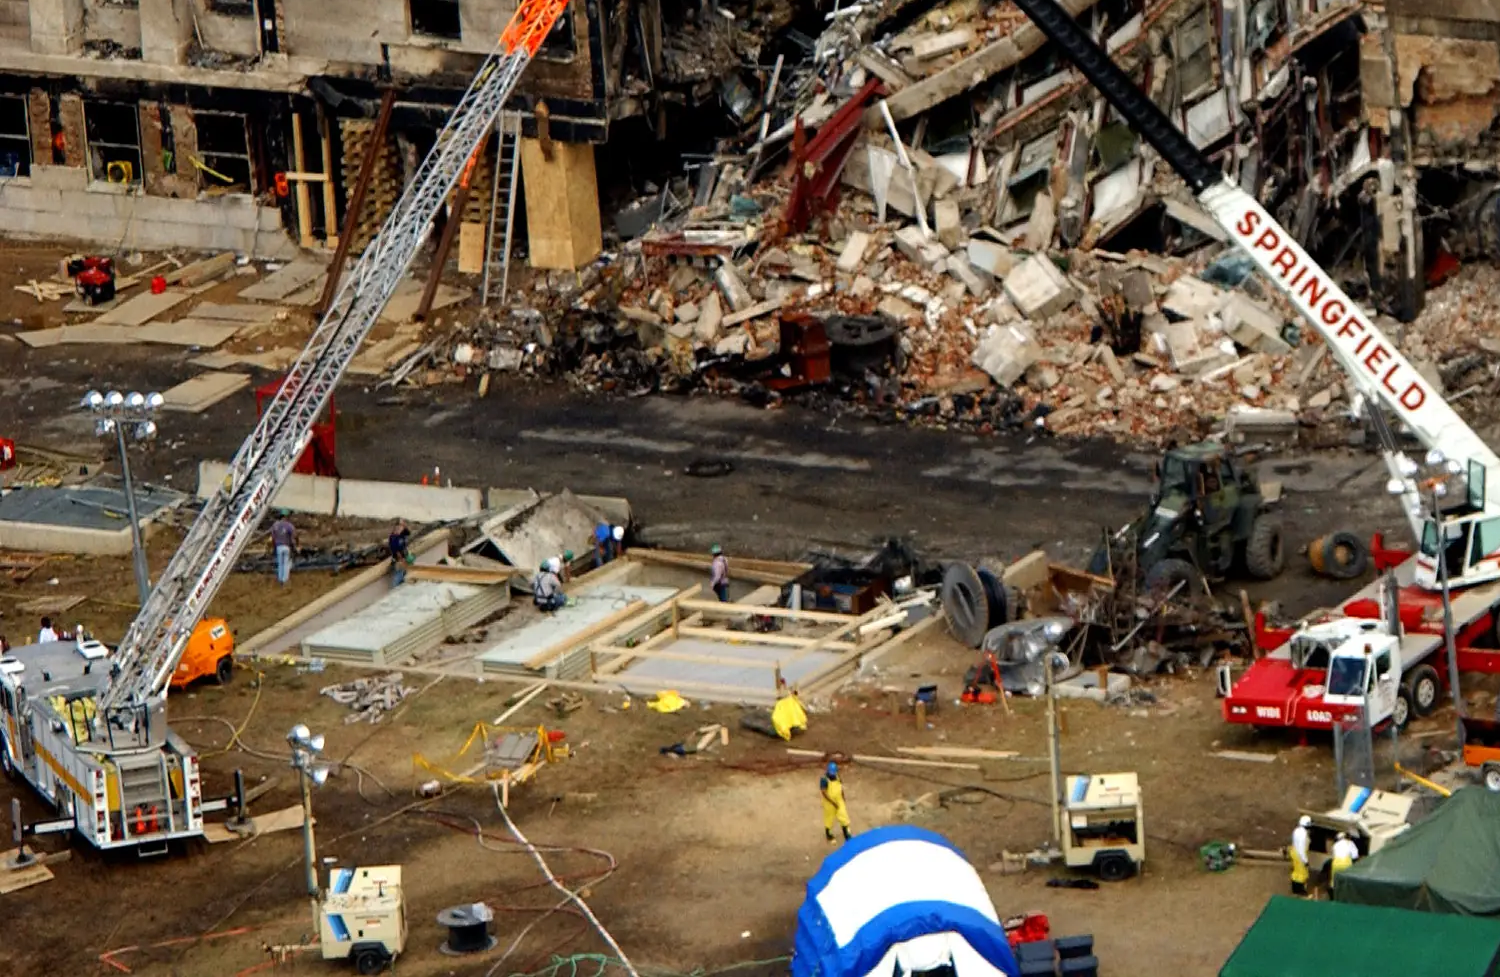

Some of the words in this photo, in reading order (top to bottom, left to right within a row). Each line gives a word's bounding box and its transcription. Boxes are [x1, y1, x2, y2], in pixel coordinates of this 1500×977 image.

[1237, 211, 1426, 410] SPRINGFIELD
[1256, 706, 1280, 719] WIDE
[1307, 709, 1332, 722] LOAD
